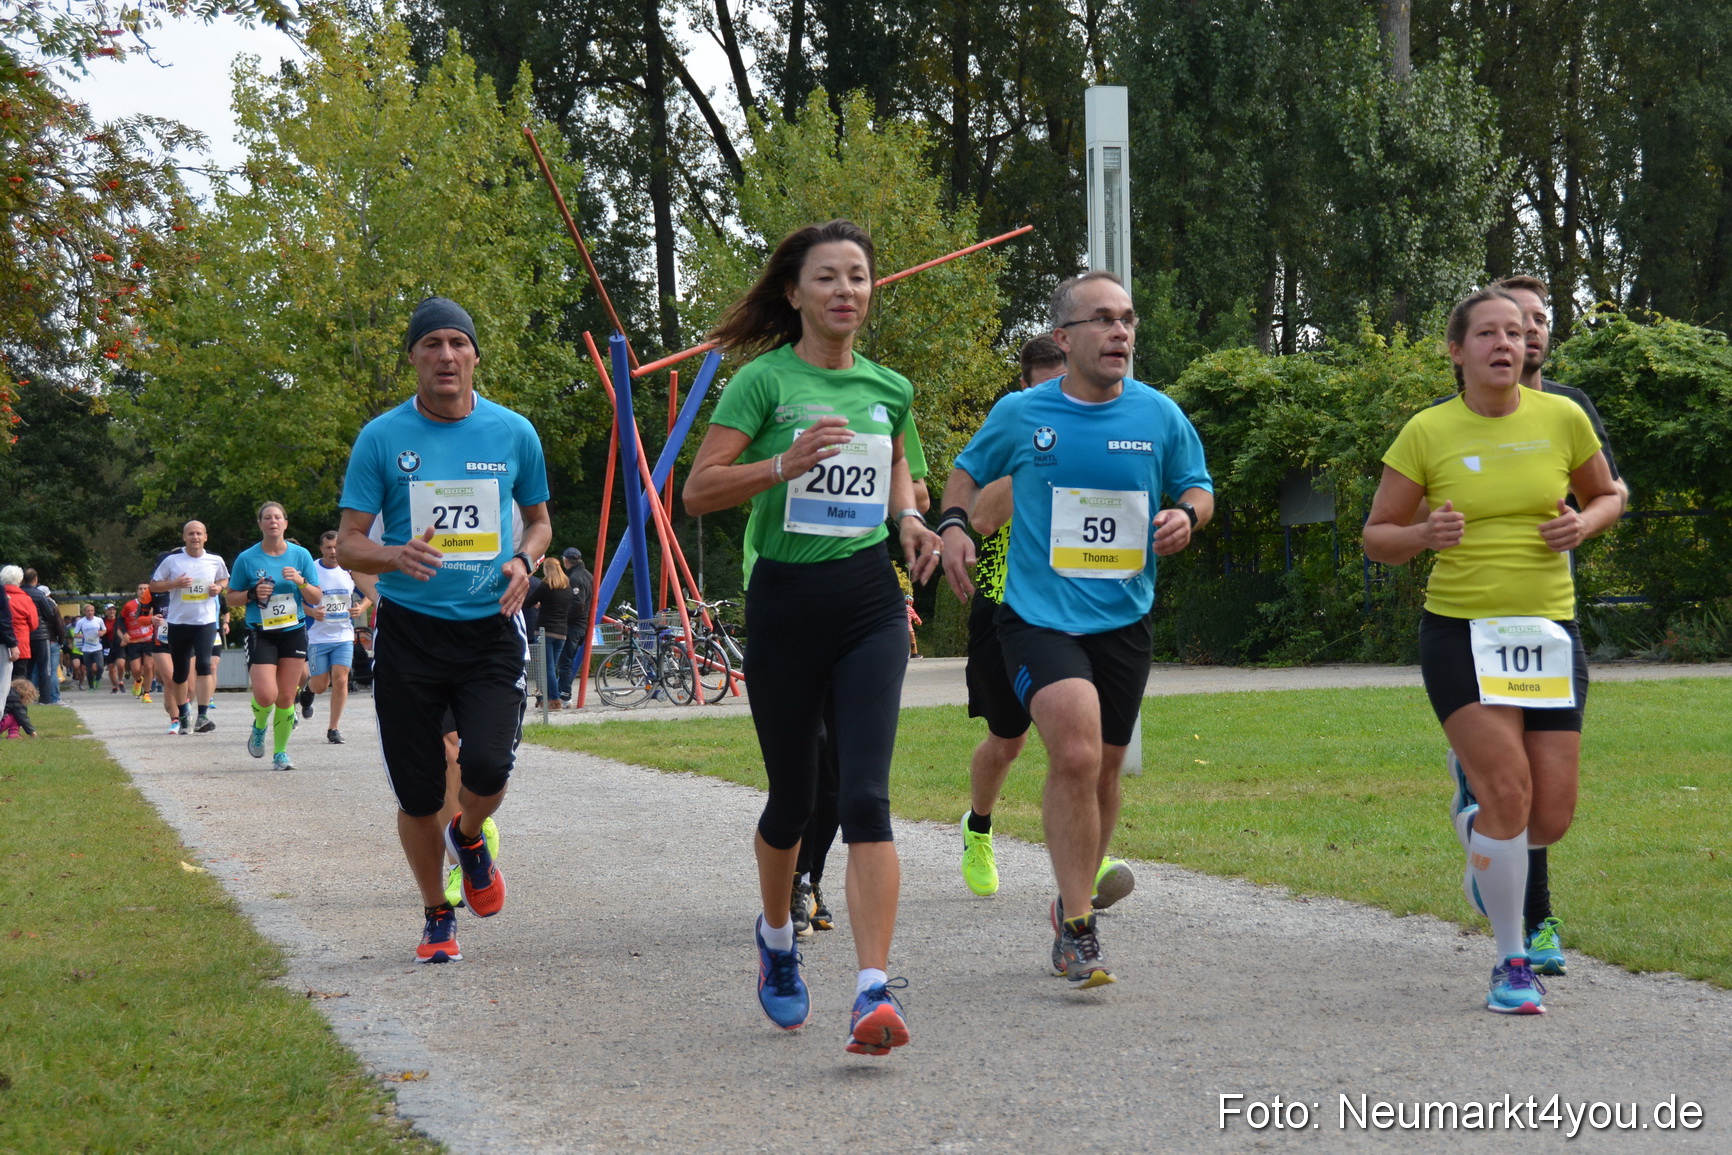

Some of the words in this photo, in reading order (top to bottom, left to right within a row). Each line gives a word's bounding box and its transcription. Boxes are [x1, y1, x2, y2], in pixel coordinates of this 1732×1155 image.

[1107, 440, 1154, 453] BOCK
[465, 461, 508, 472] BOCK
[806, 464, 876, 497] 2023
[444, 487, 474, 495] BOCK
[1088, 497, 1121, 506] BOCK
[432, 505, 479, 530] 273
[827, 506, 856, 519] Maria
[1083, 517, 1116, 543] 59
[442, 538, 474, 547] Johann
[1083, 552, 1119, 563] Thomas
[189, 585, 204, 594] 145
[272, 604, 286, 615] 52
[326, 602, 346, 612] 2307
[1508, 625, 1542, 633] BOCK
[1495, 645, 1543, 672] 101
[1507, 681, 1541, 692] Andrea
